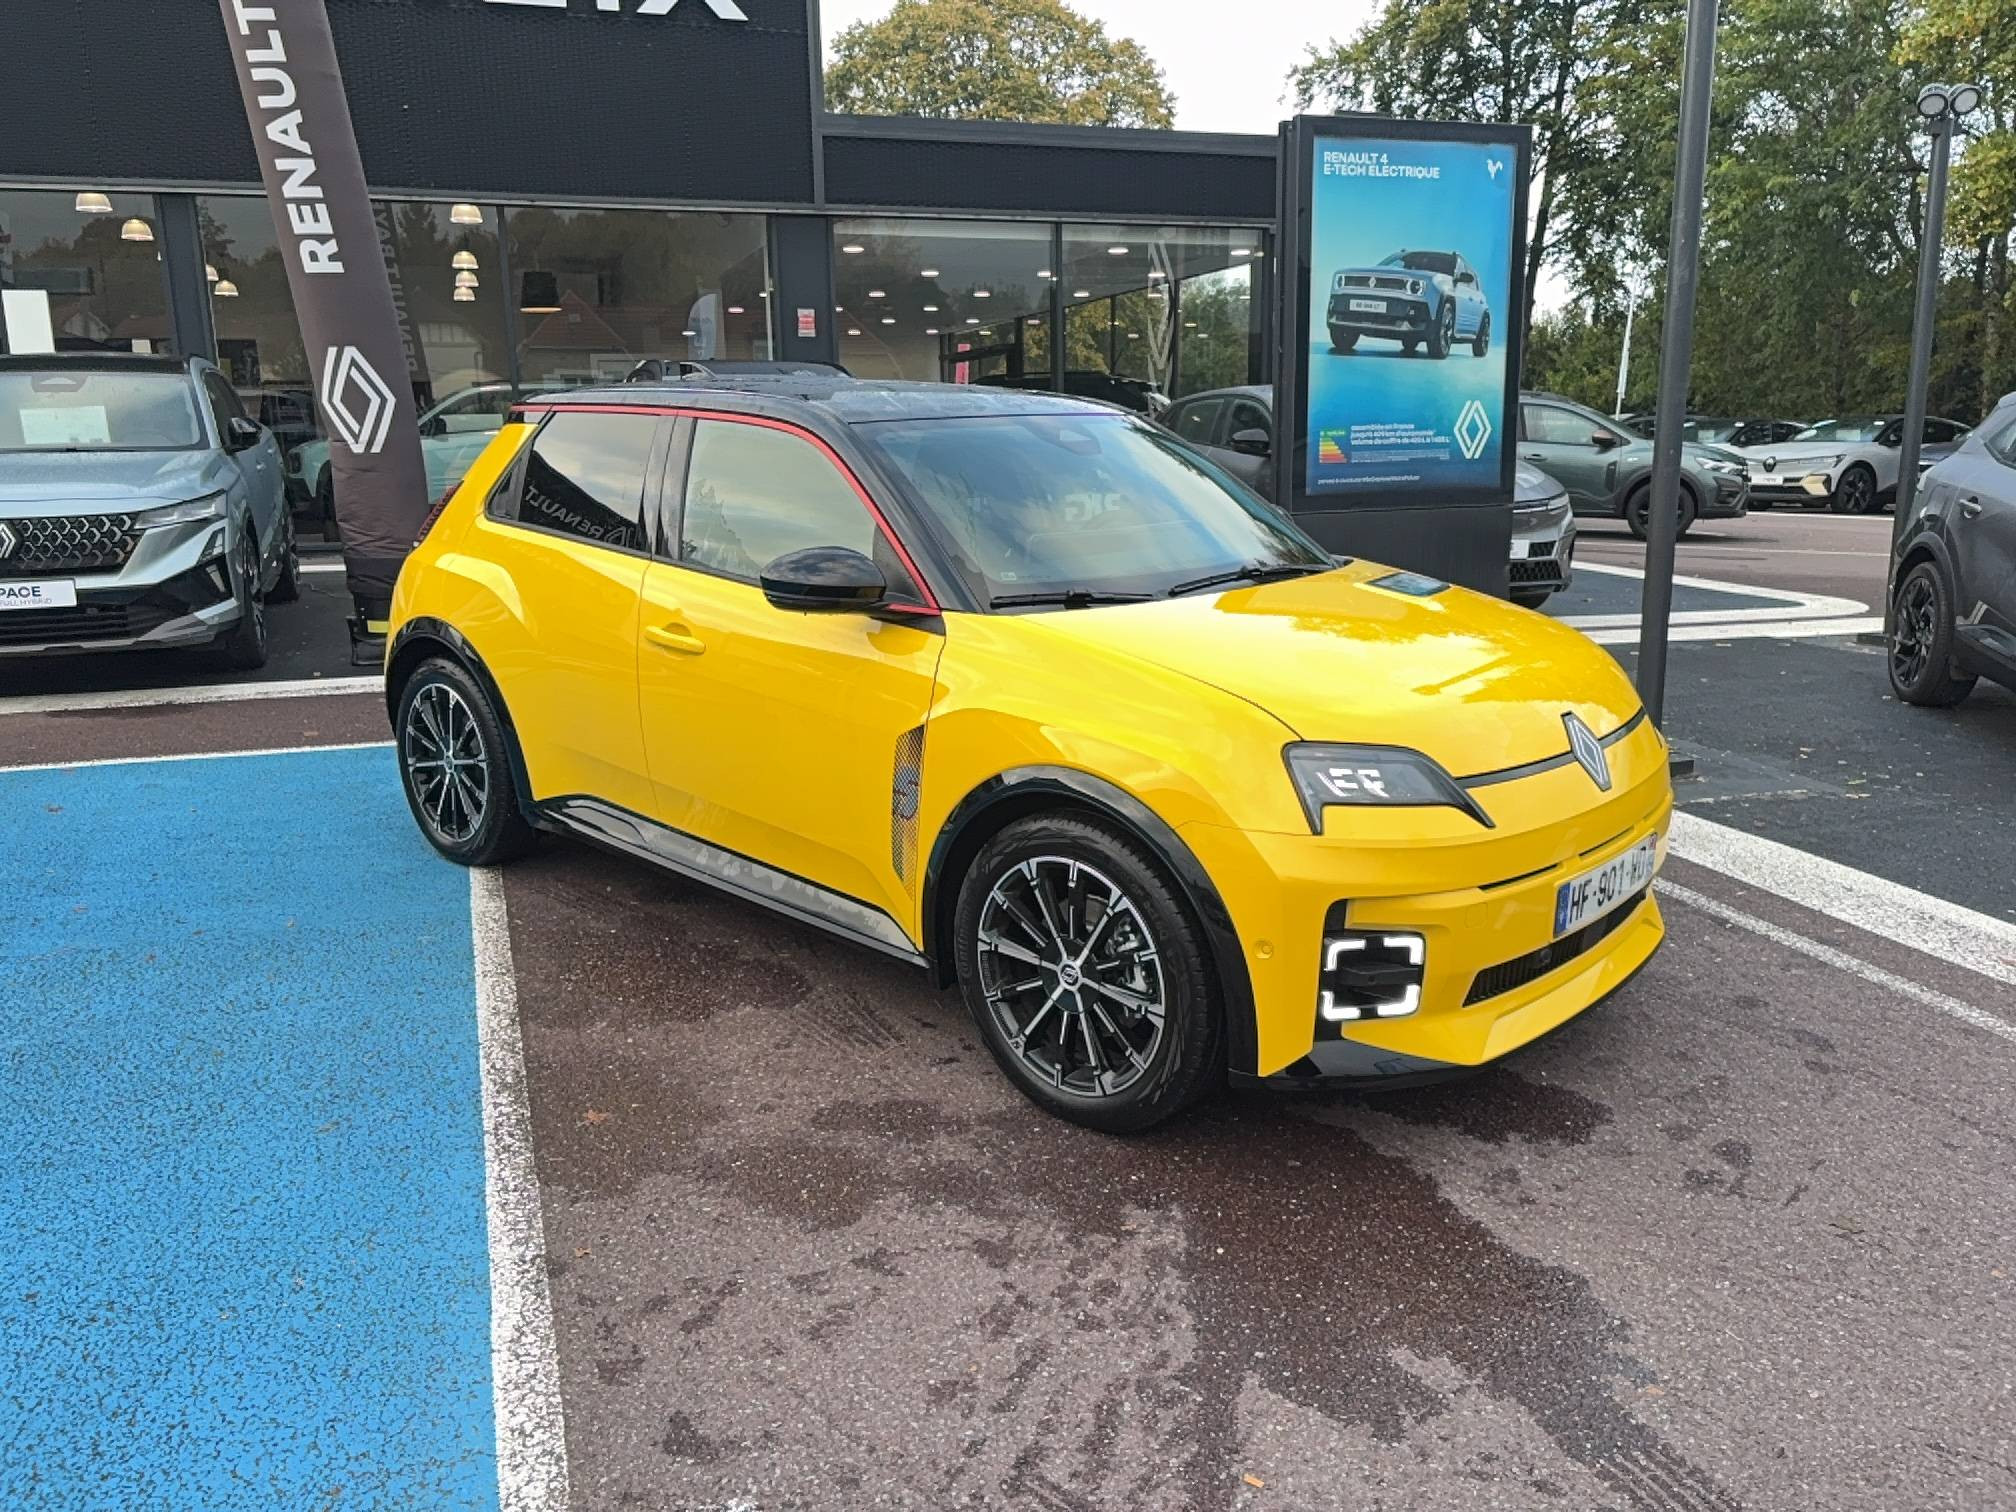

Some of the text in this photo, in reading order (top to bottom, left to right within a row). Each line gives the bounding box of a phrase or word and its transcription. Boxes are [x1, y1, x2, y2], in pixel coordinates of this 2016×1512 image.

[232, 0, 345, 274] RENAULT
[1323, 151, 1388, 165] RENAULT 4
[1323, 164, 1366, 176] E-TECH
